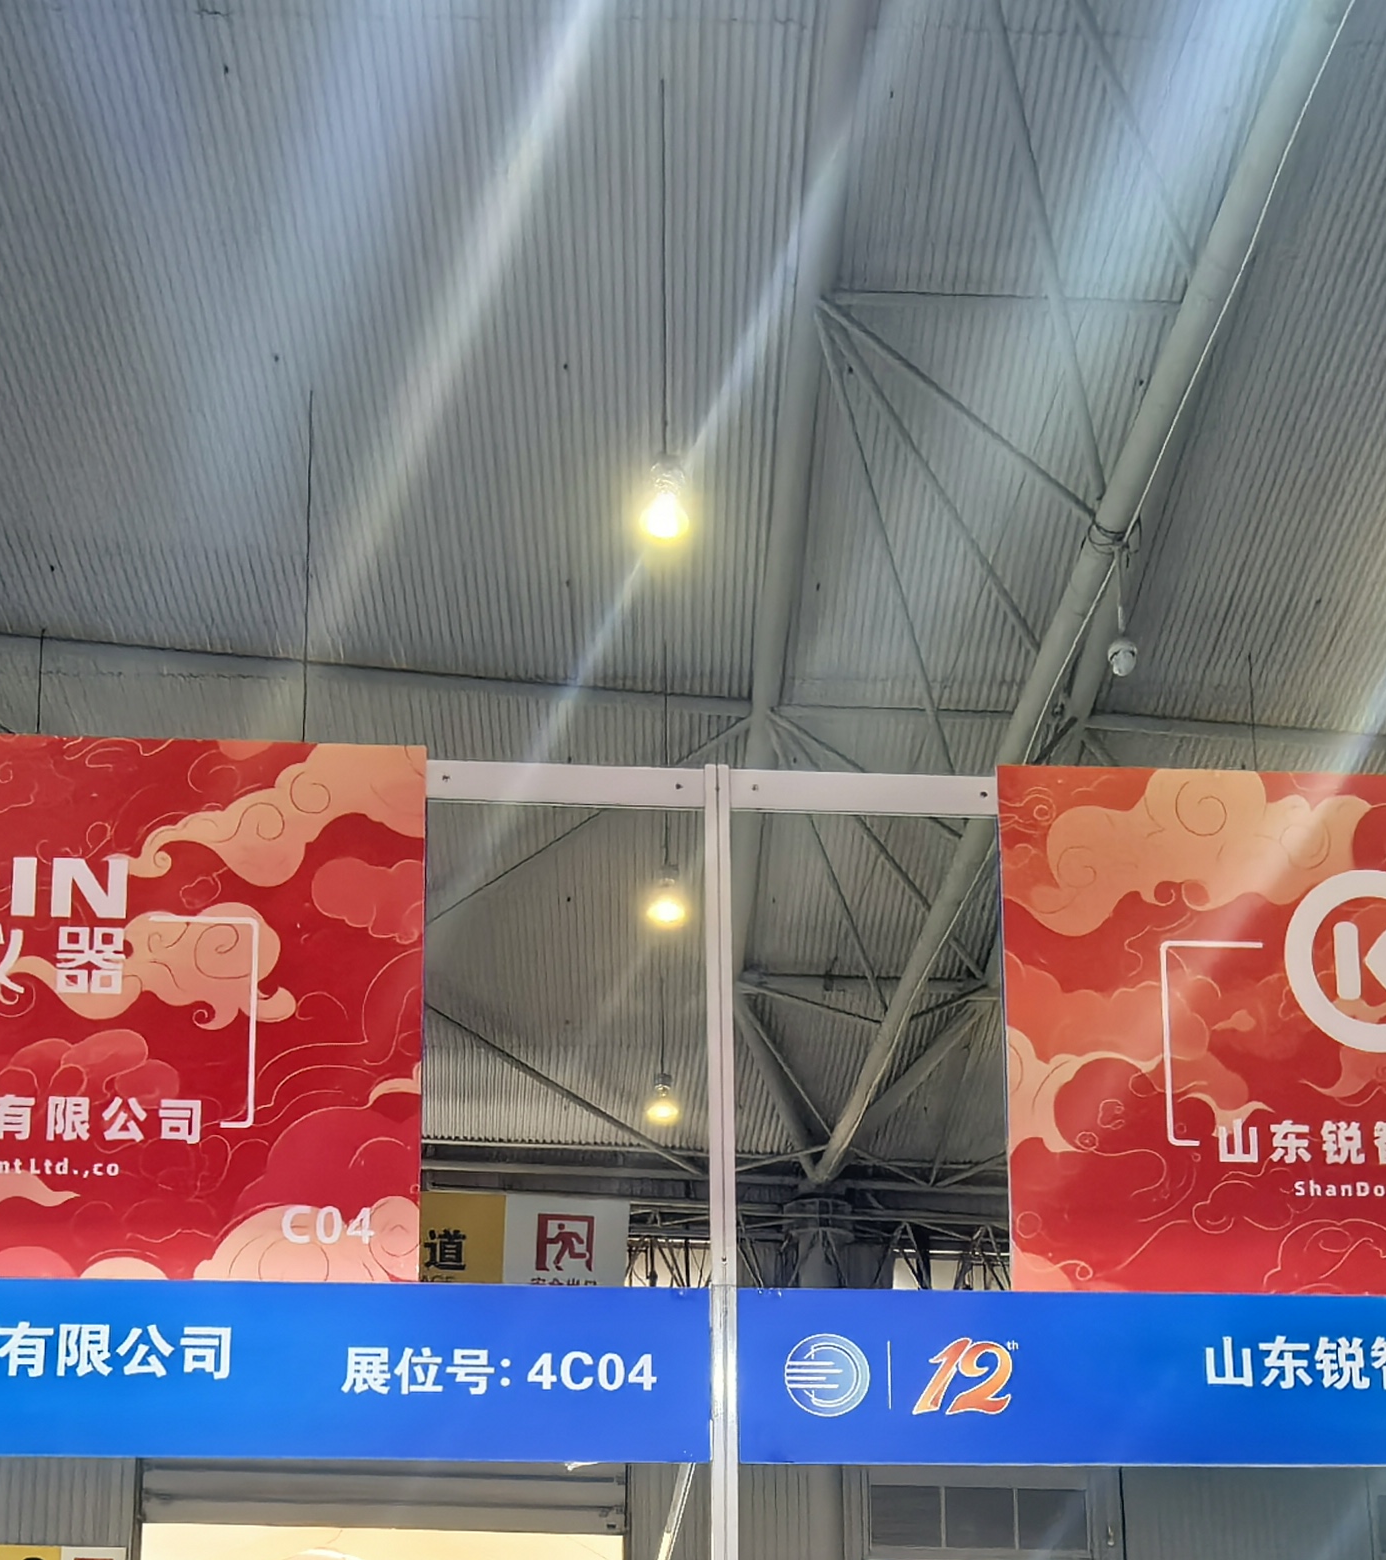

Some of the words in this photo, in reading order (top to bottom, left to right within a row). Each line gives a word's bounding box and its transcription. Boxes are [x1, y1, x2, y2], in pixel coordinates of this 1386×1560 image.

[280, 1206, 375, 1246] C04
[423, 1228, 466, 1271] 道
[341, 1347, 512, 1396] 展位号:
[526, 1350, 658, 1392] 4C04
